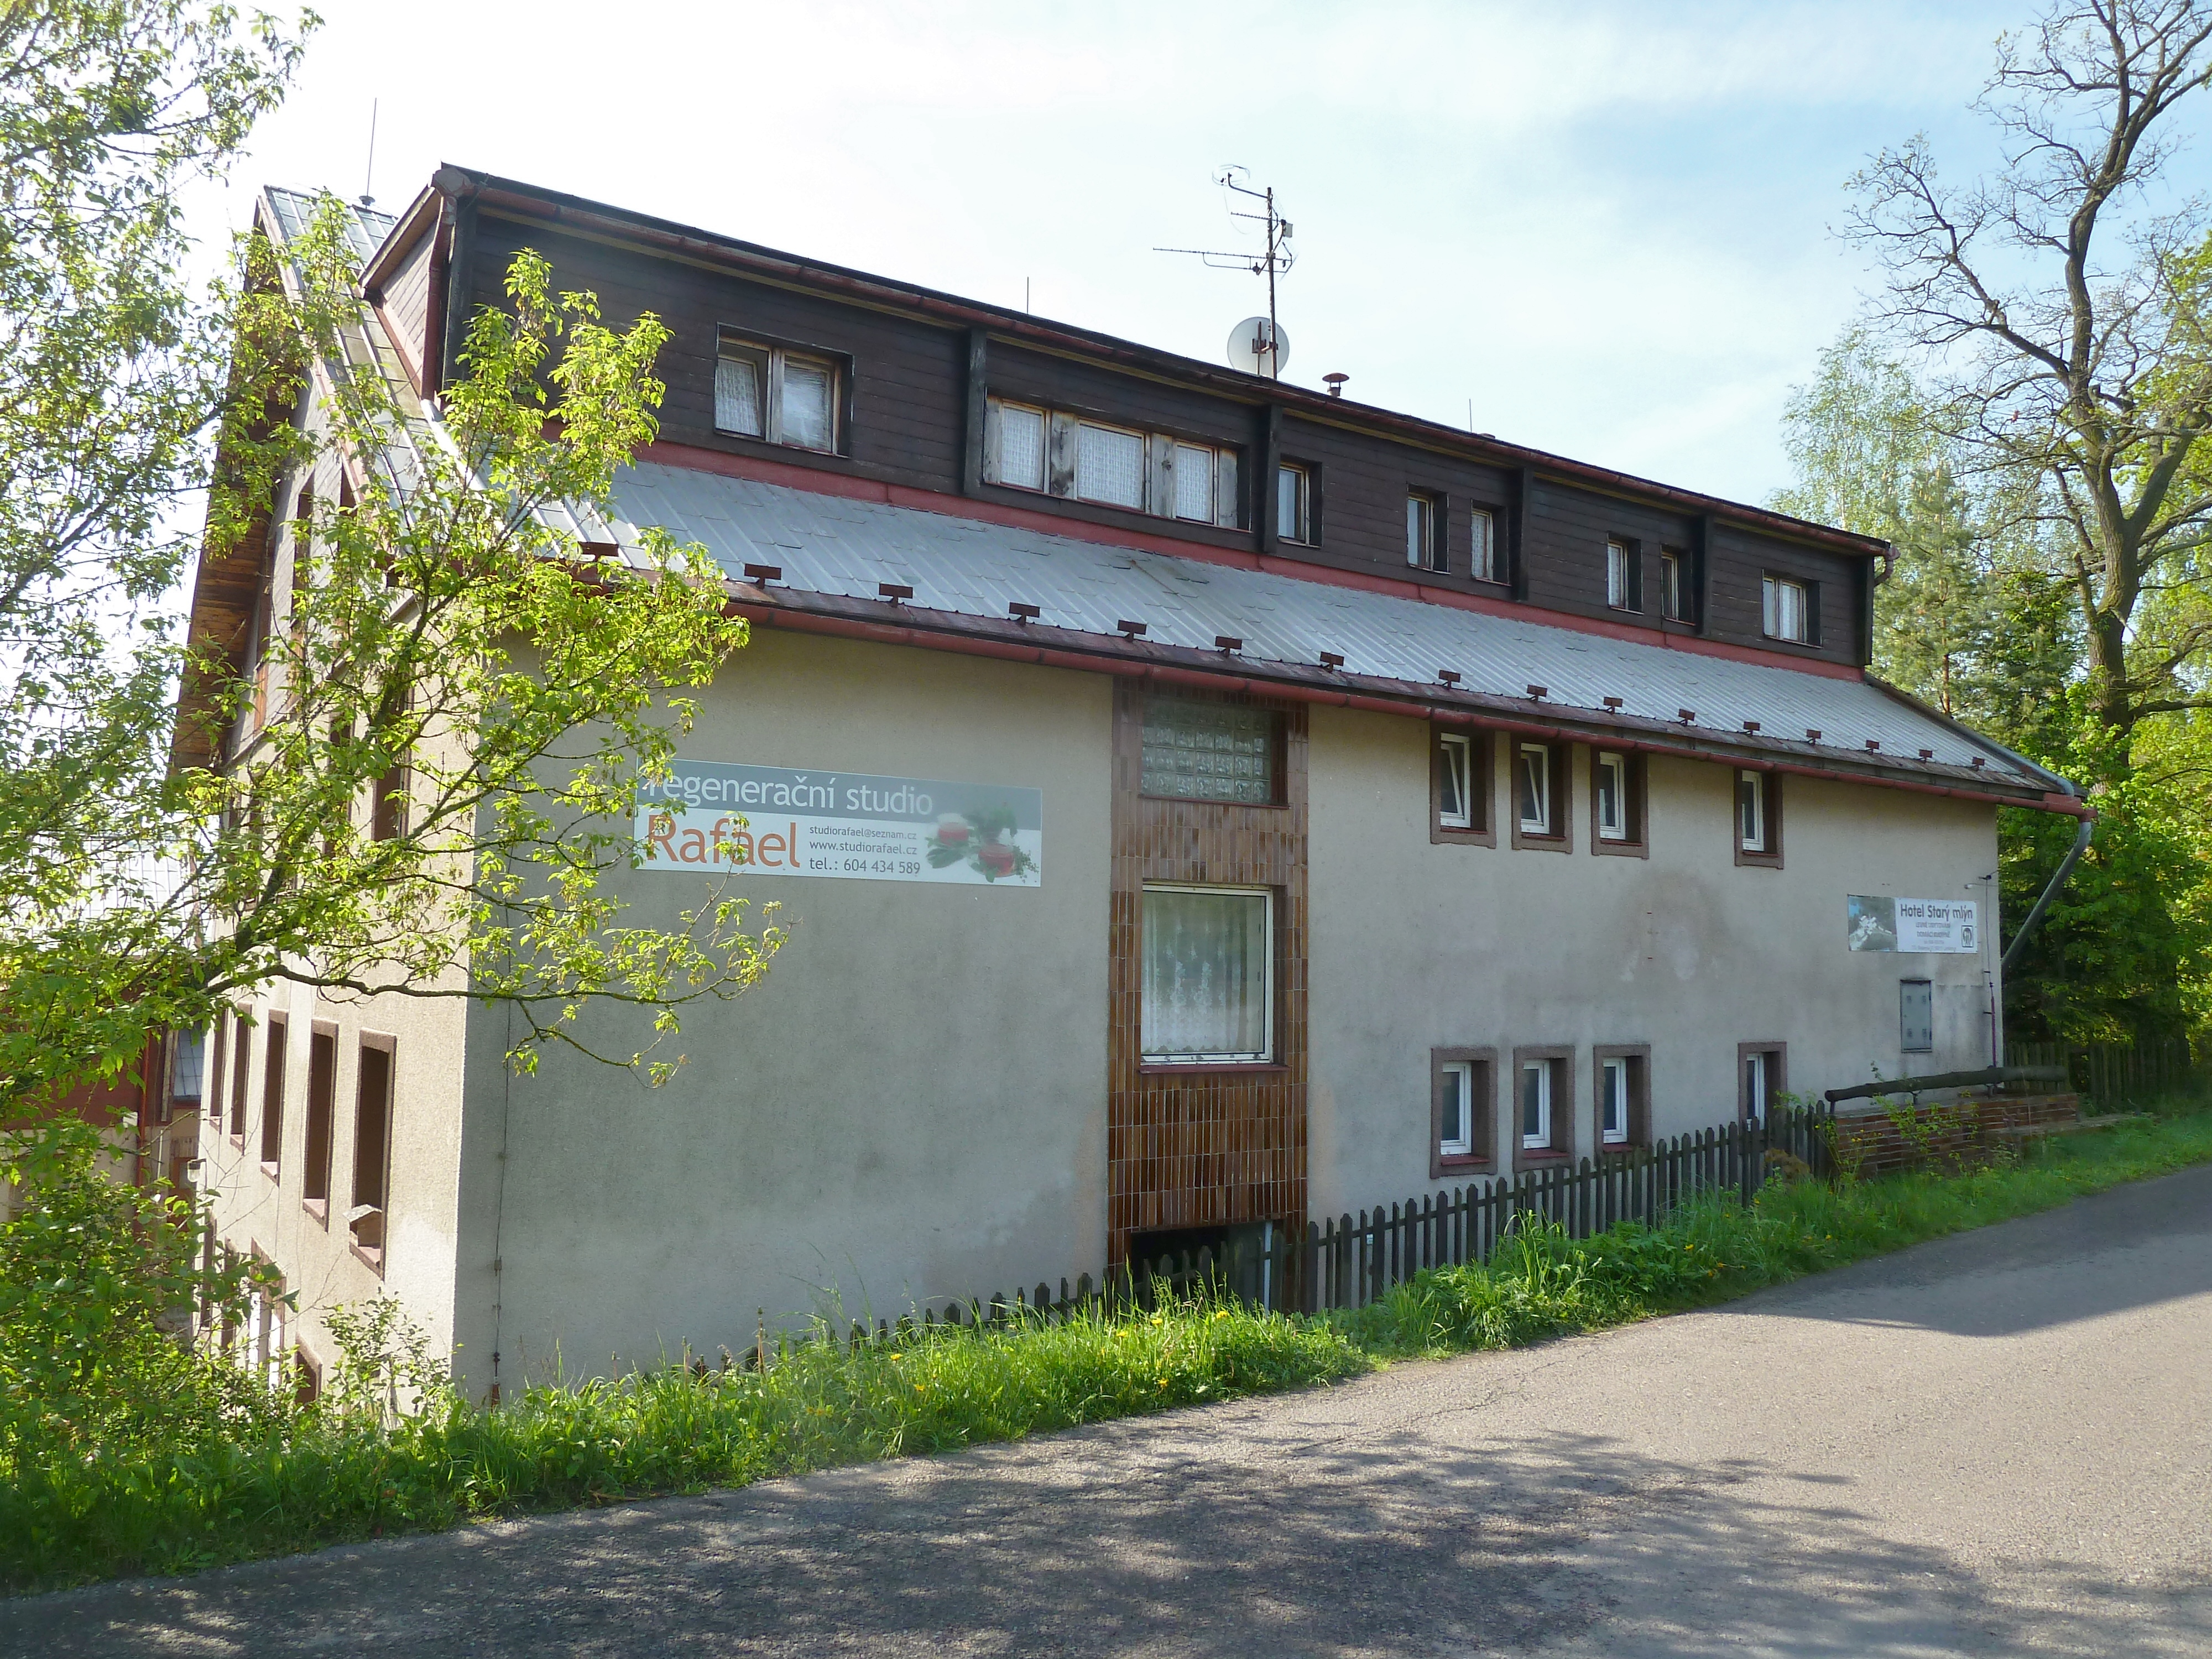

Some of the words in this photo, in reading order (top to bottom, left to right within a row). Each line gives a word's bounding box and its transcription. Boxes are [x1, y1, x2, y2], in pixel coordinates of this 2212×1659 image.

[846, 785, 933, 815] studio
[647, 814, 800, 868] Rafael
[809, 826, 917, 840] studiorafael@seznam.cz
[809, 841, 917, 855] www.studiorafael.cz
[809, 857, 838, 870] tel.:
[844, 858, 867, 872] 604
[871, 860, 894, 873] 434
[899, 861, 921, 874] 589
[1900, 904, 1924, 917] Hotel
[1927, 904, 1949, 922] Starý
[1952, 905, 1973, 922] mlýn
